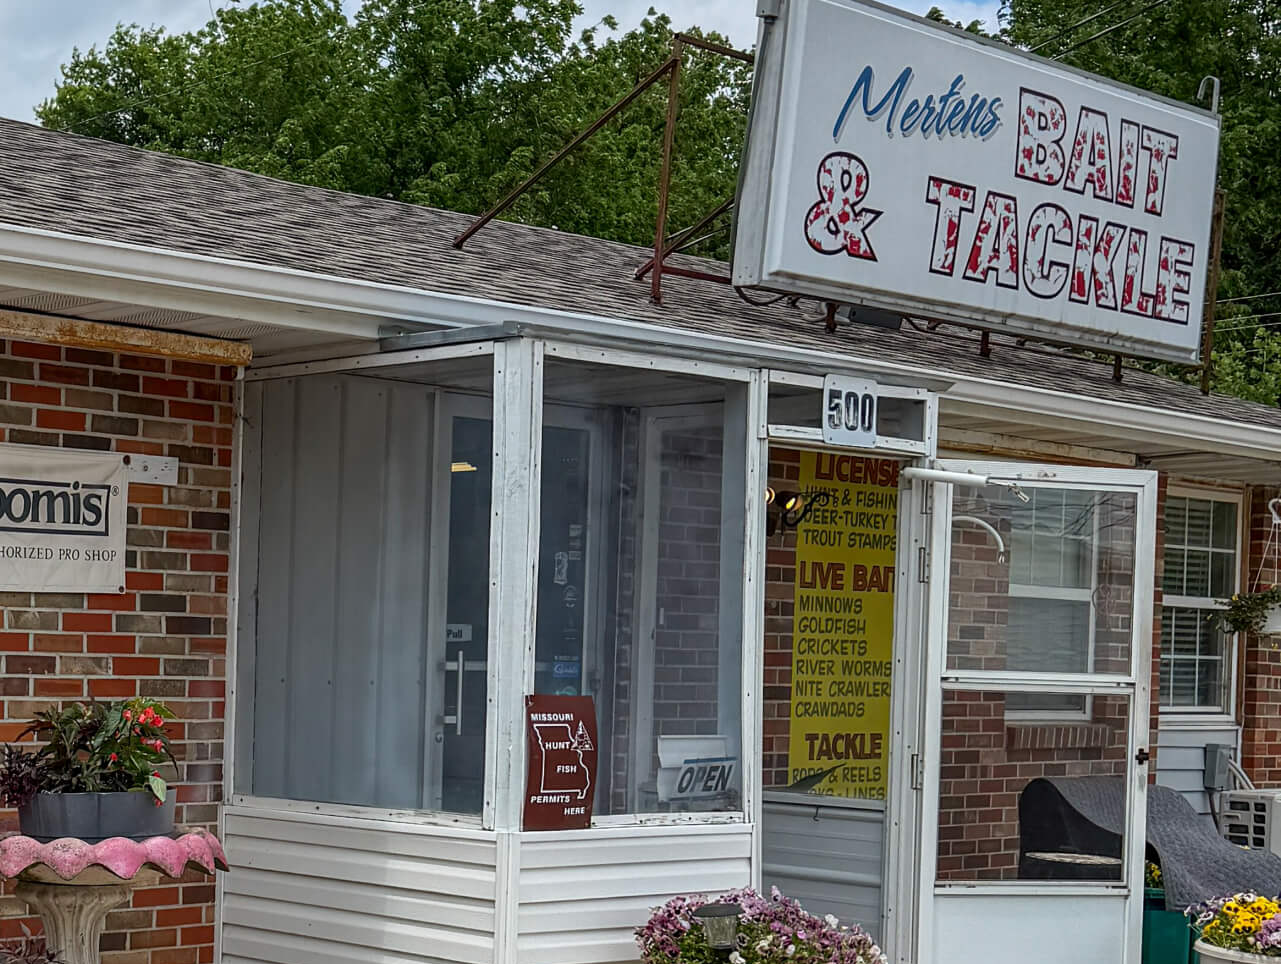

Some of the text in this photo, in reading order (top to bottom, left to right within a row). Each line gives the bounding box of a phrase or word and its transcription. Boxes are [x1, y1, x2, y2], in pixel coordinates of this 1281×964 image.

[832, 65, 1179, 217] Mertens BAIT
[804, 151, 1196, 325] & TACKLE
[827, 389, 875, 432] 500
[803, 508, 888, 530] DEER-TURKEY
[803, 529, 897, 552] TROUT STAMPS
[59, 548, 80, 561] PRO
[84, 549, 117, 562] SHOP
[799, 560, 845, 590] LIVE
[799, 595, 863, 615] MINNOWS
[447, 628, 463, 639] Pull
[798, 617, 867, 635] GOLDFISH
[797, 638, 868, 657] CRICKETS
[796, 659, 892, 678] RIVER WORMS
[795, 680, 891, 698] NITE CRAWLER
[530, 713, 574, 721] MISSOURI
[795, 702, 865, 718] CRAWDADS
[805, 733, 883, 761] TACKLE
[556, 765, 577, 773] FISH
[842, 767, 882, 783] REELS
[677, 764, 733, 794] OPEN
[530, 795, 571, 804] PERMITS
[564, 807, 585, 815] HERE
